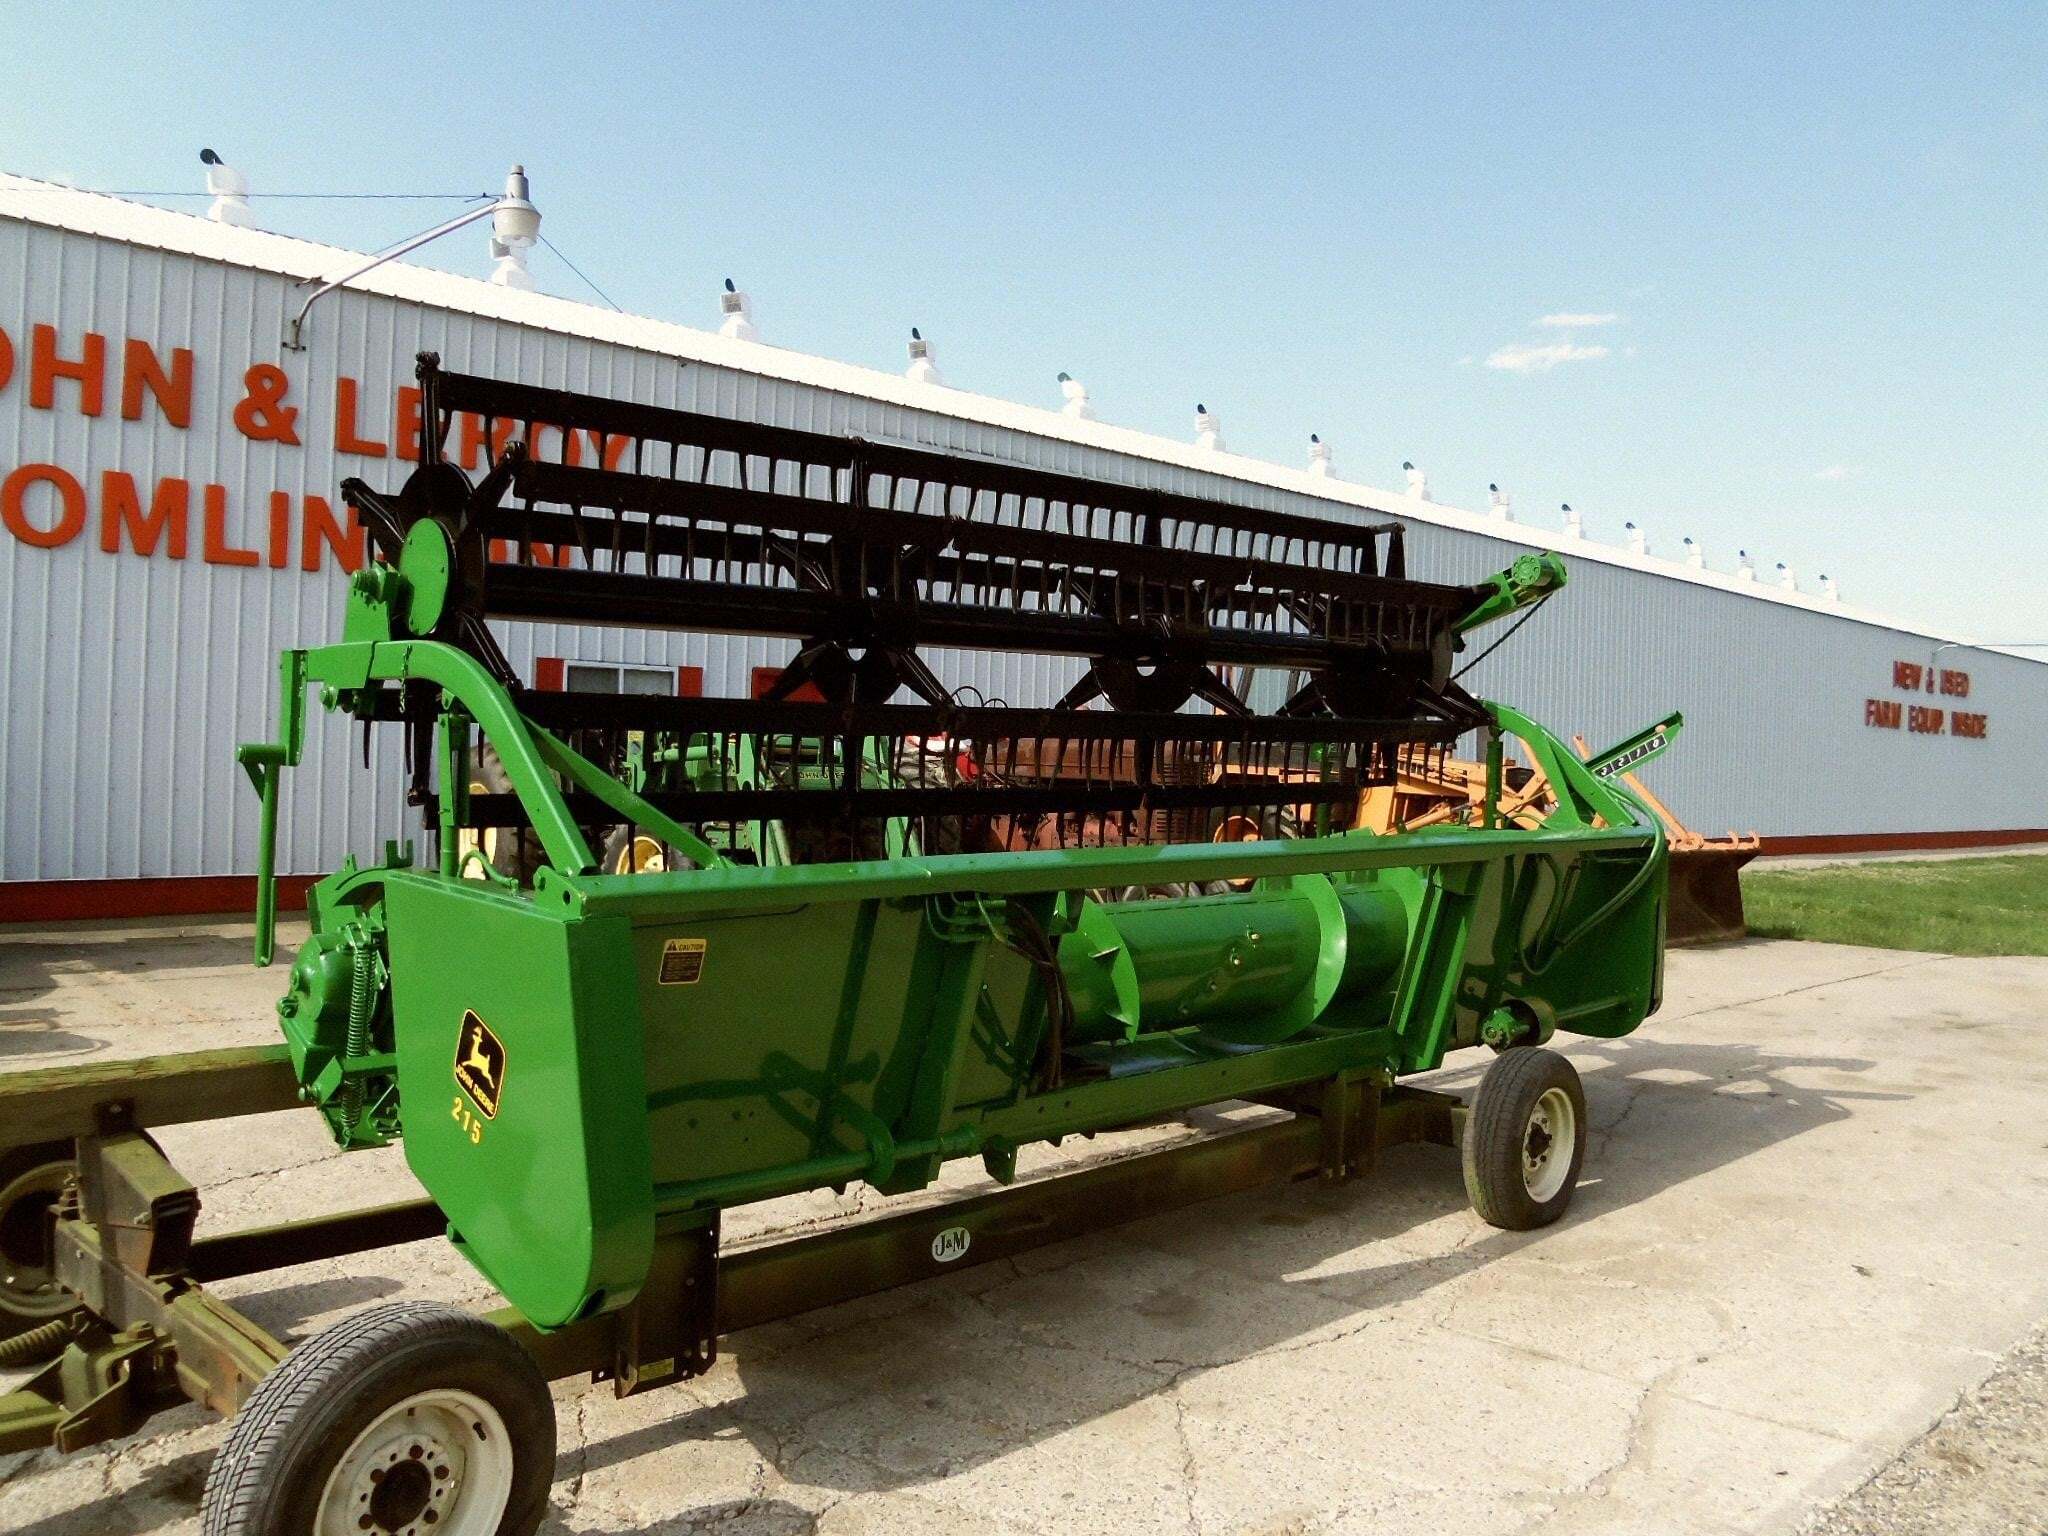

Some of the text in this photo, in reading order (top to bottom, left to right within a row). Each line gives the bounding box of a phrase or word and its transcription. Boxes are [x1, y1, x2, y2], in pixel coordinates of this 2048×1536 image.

[0, 322, 195, 429] HN
[233, 363, 301, 446] &
[456, 1064, 496, 1115] JOHN DEERE
[452, 1096, 482, 1144] 215
[935, 1229, 966, 1257] J&M
